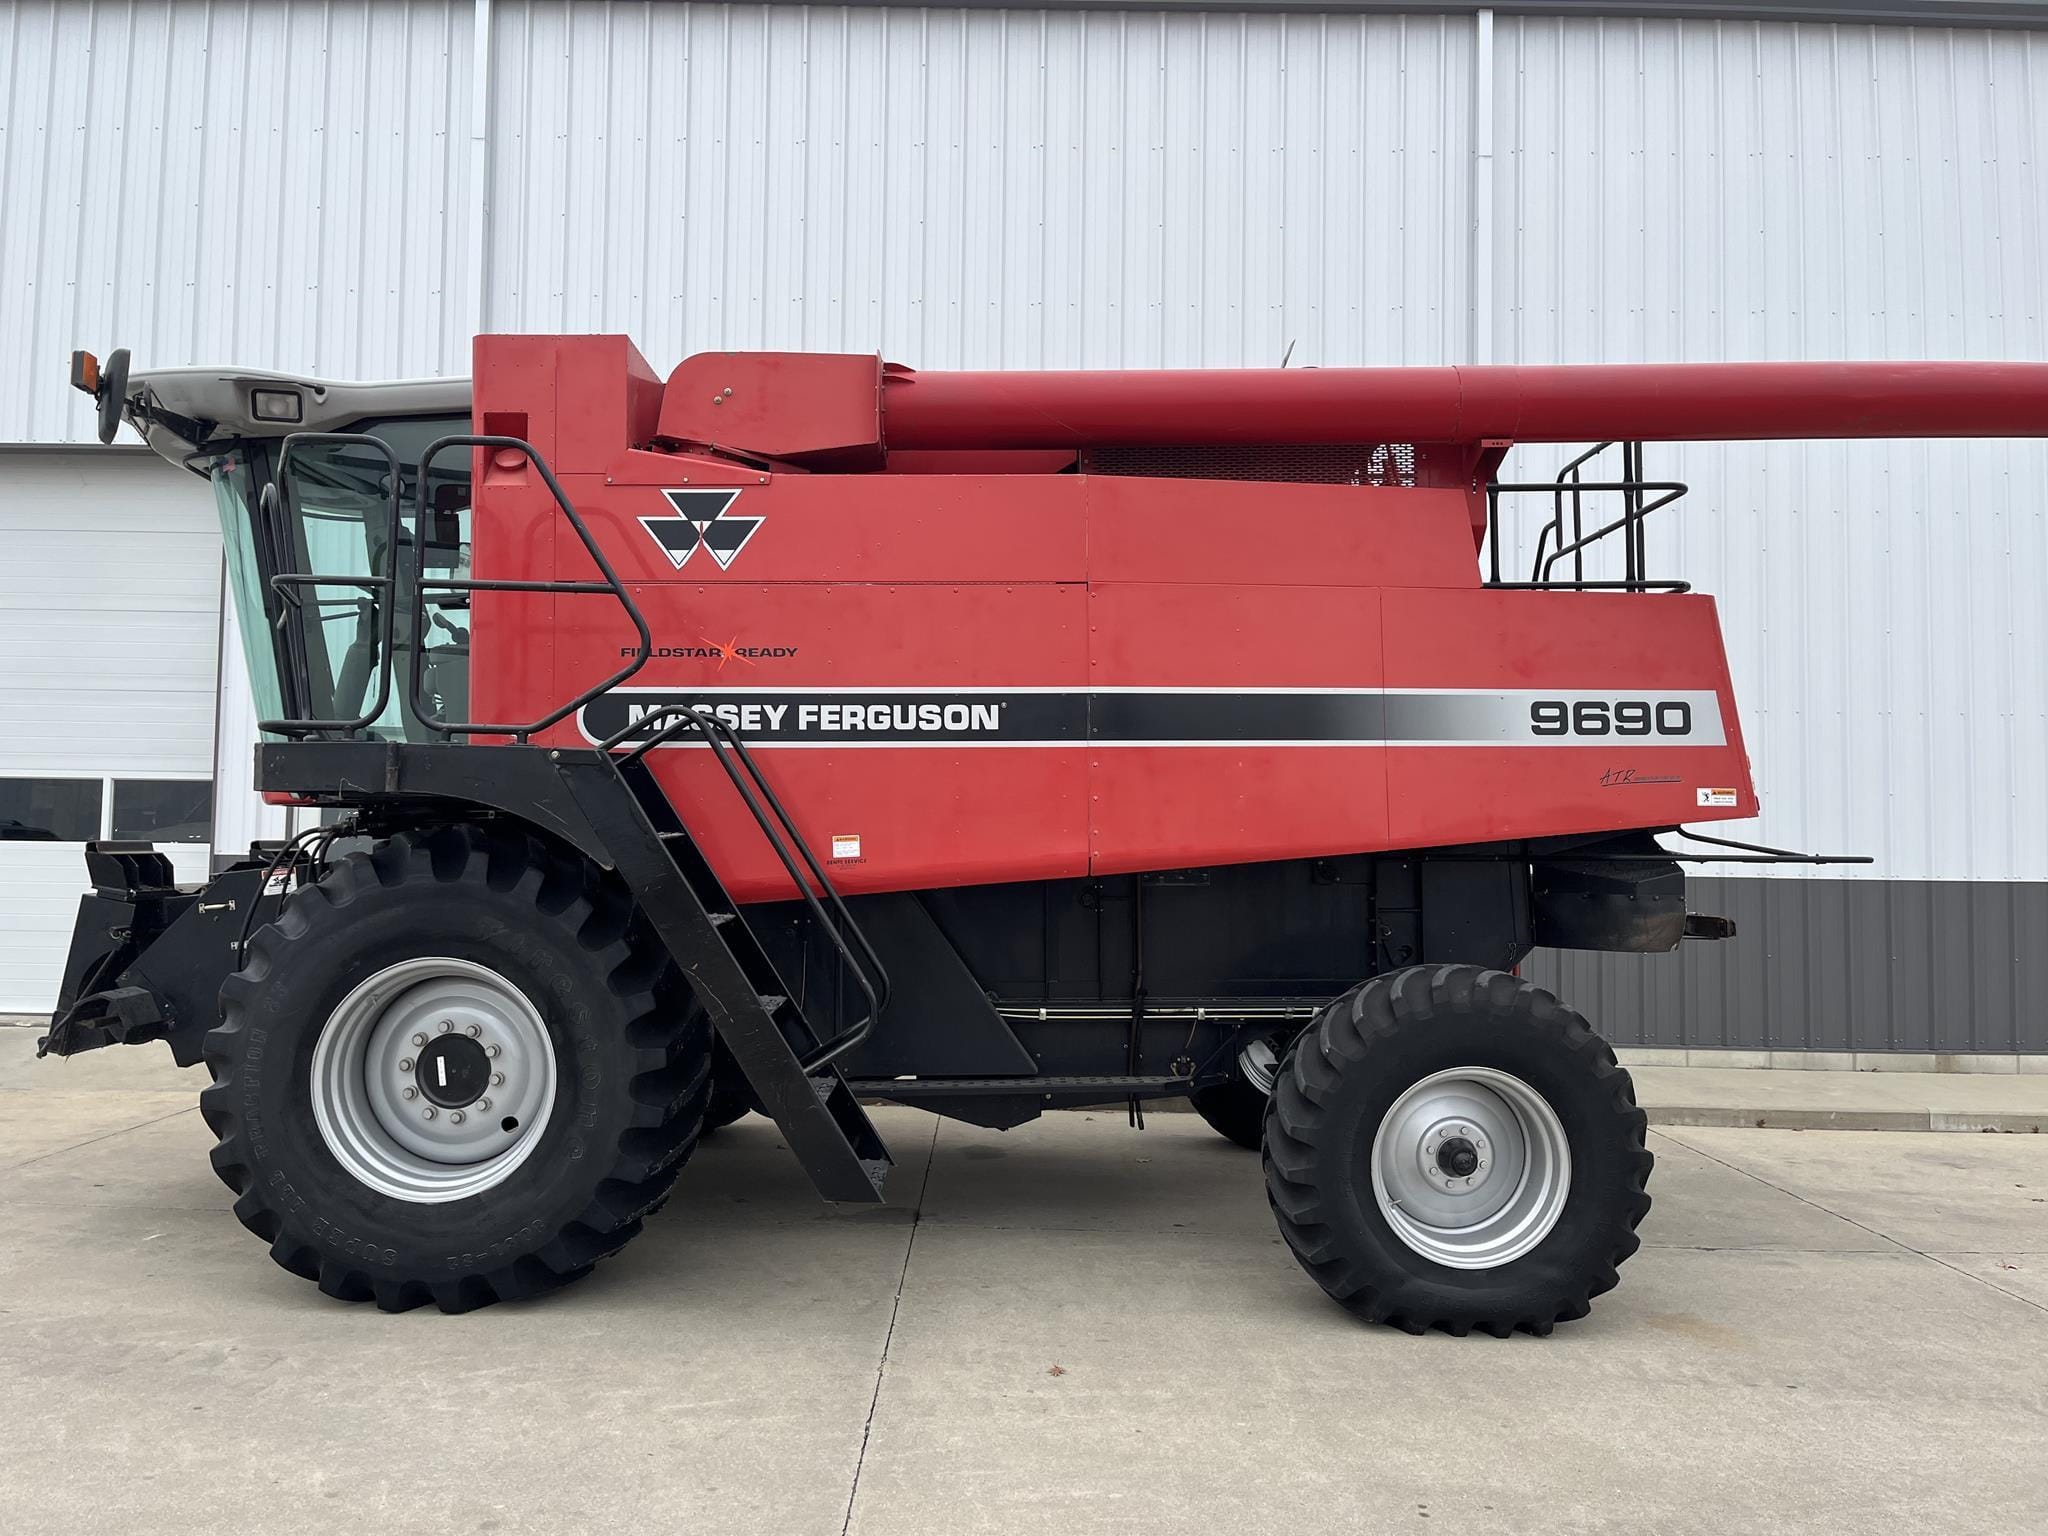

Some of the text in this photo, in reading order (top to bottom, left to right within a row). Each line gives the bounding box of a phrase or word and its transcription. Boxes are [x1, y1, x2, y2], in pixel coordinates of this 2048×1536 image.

[735, 647, 798, 658] READY
[798, 703, 1001, 731] FERGUSON
[1530, 700, 1692, 736] 9690
[1599, 768, 1636, 785] ATR
[479, 915, 602, 1162] Firestone
[243, 1028, 269, 1160] TRACTION
[268, 1168, 309, 1215] ALL
[311, 1216, 399, 1267] SUPER
